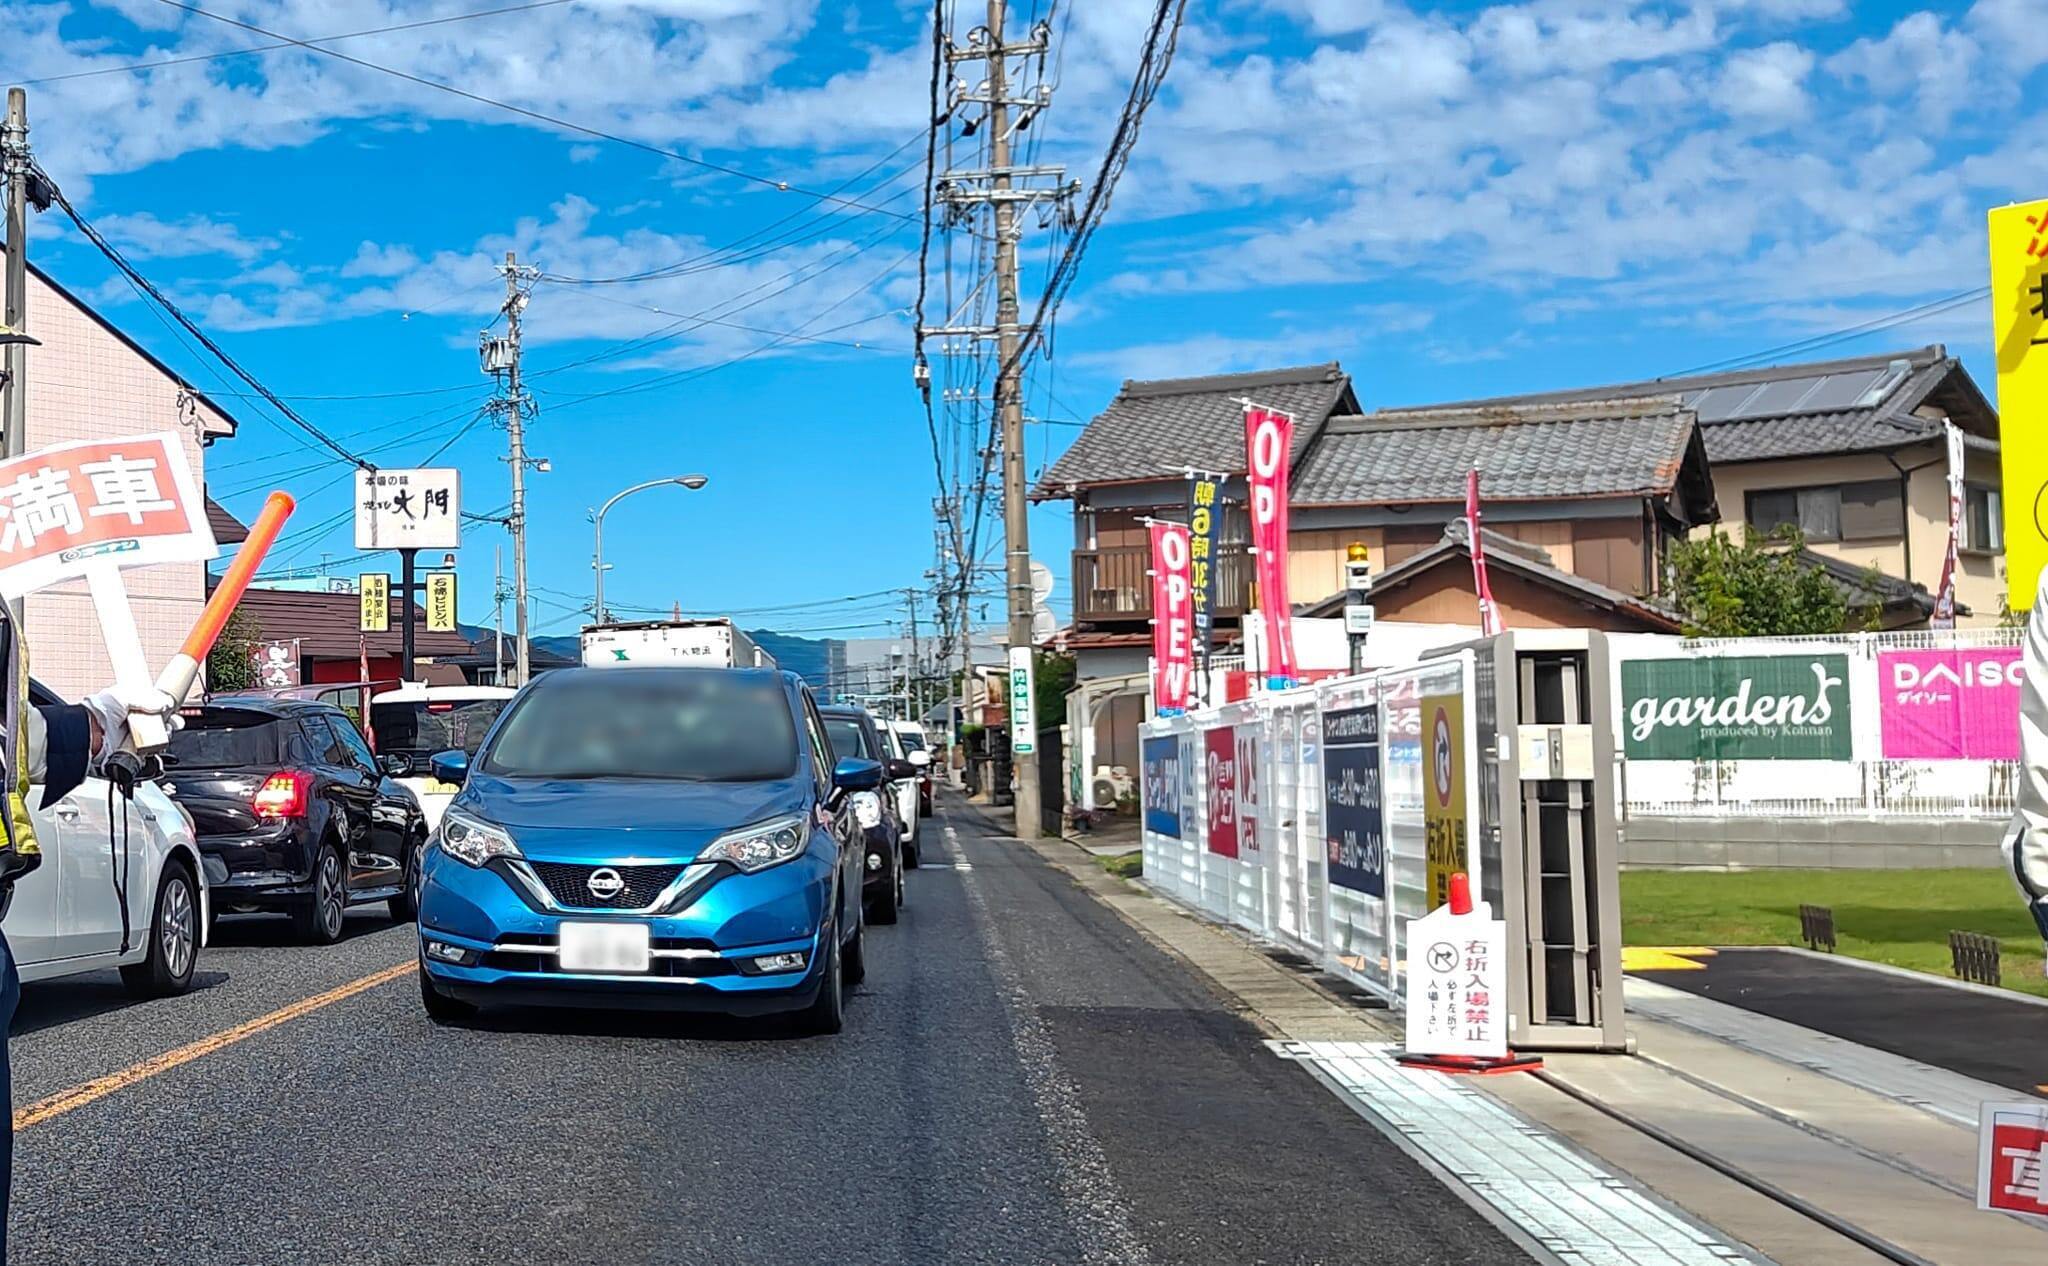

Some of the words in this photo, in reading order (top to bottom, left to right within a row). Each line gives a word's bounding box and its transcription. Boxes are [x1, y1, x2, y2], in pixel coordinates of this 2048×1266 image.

[365, 475, 409, 486] 本場の味
[0, 453, 177, 553] 満車
[364, 587, 373, 627] 承ります
[433, 577, 448, 627] 石焼ビビンバ
[1161, 530, 1186, 701] OPEN
[1893, 660, 2024, 688] DAISO
[1896, 690, 1952, 705] ダイソー
[1700, 724, 1758, 739] produced
[1761, 724, 1778, 740] by
[1782, 723, 1832, 737] Kohnan
[1465, 940, 1489, 1041] 右折入場禁止
